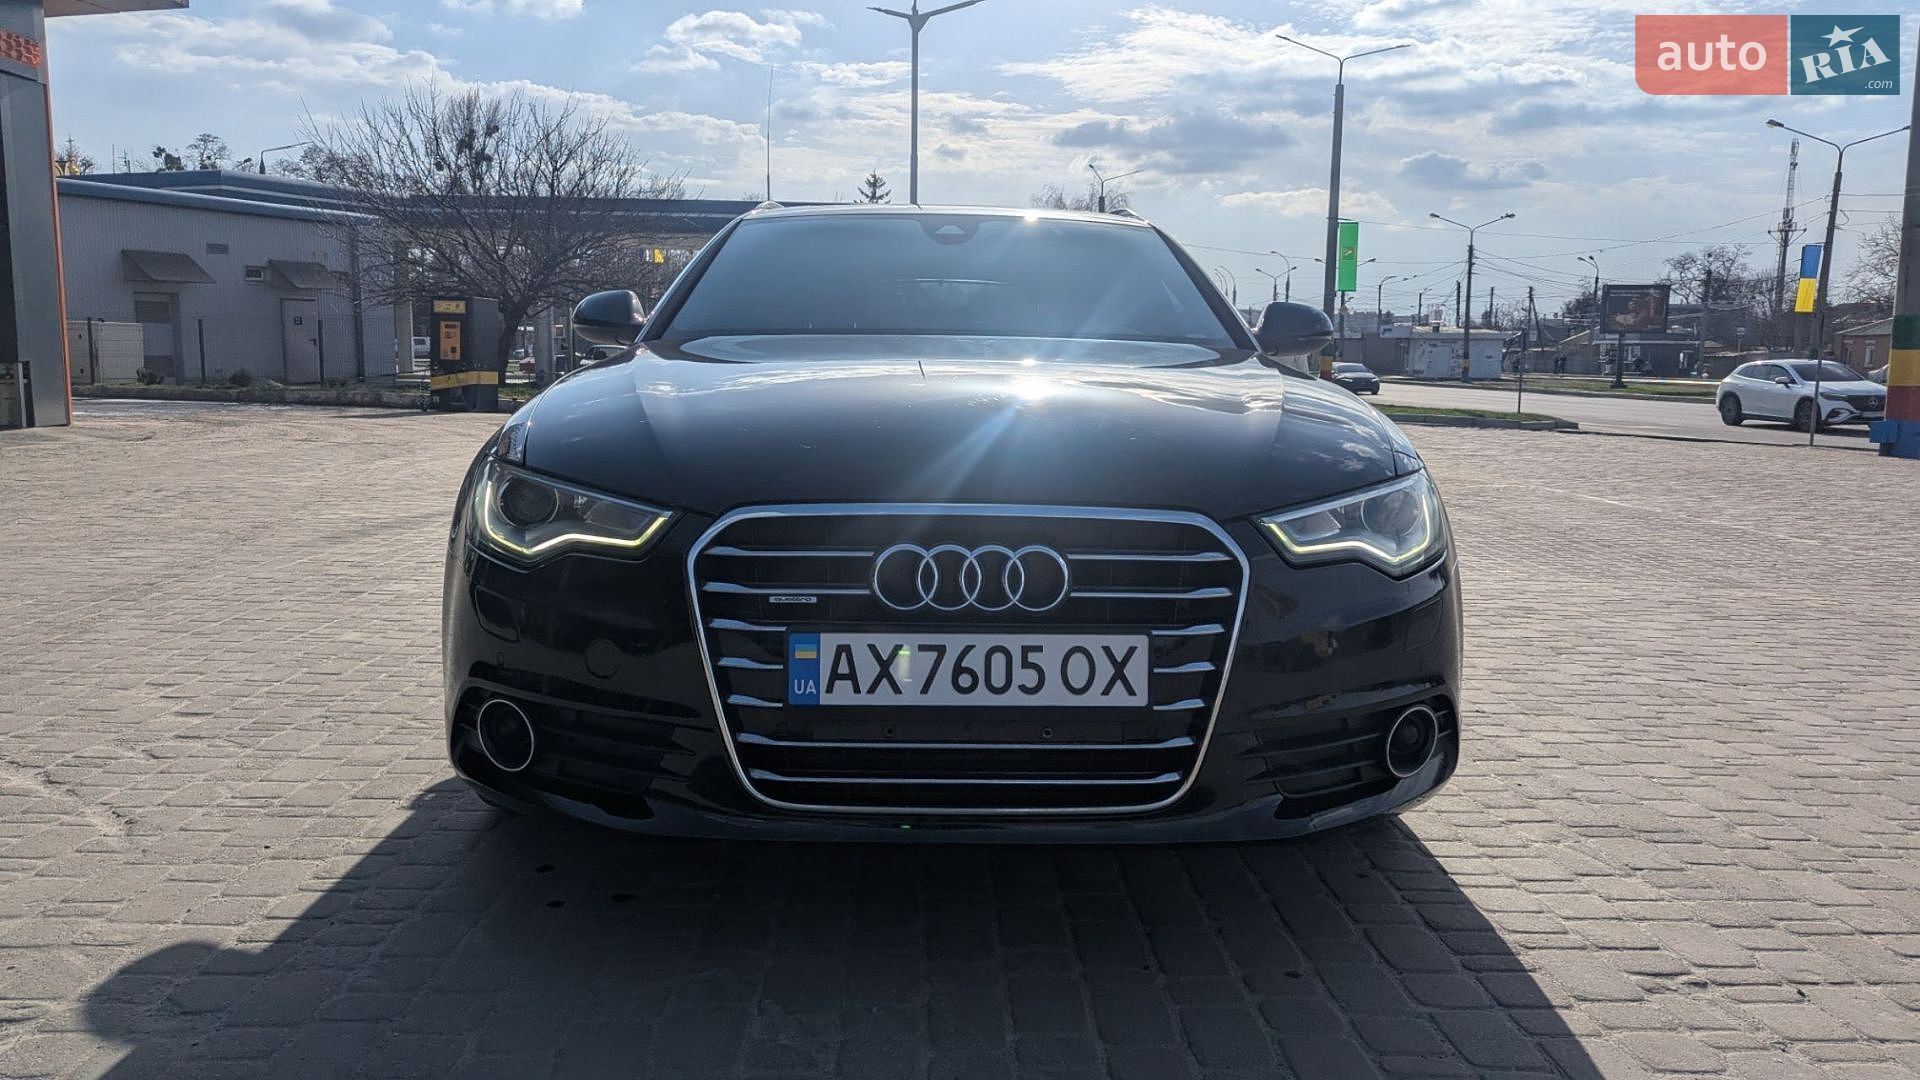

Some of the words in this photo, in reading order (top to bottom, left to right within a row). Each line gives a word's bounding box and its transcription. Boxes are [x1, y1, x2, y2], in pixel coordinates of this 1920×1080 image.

[794, 679, 817, 695] UA
[825, 643, 905, 695] AX
[917, 643, 1046, 696] 7605
[1060, 645, 1138, 697] OX
